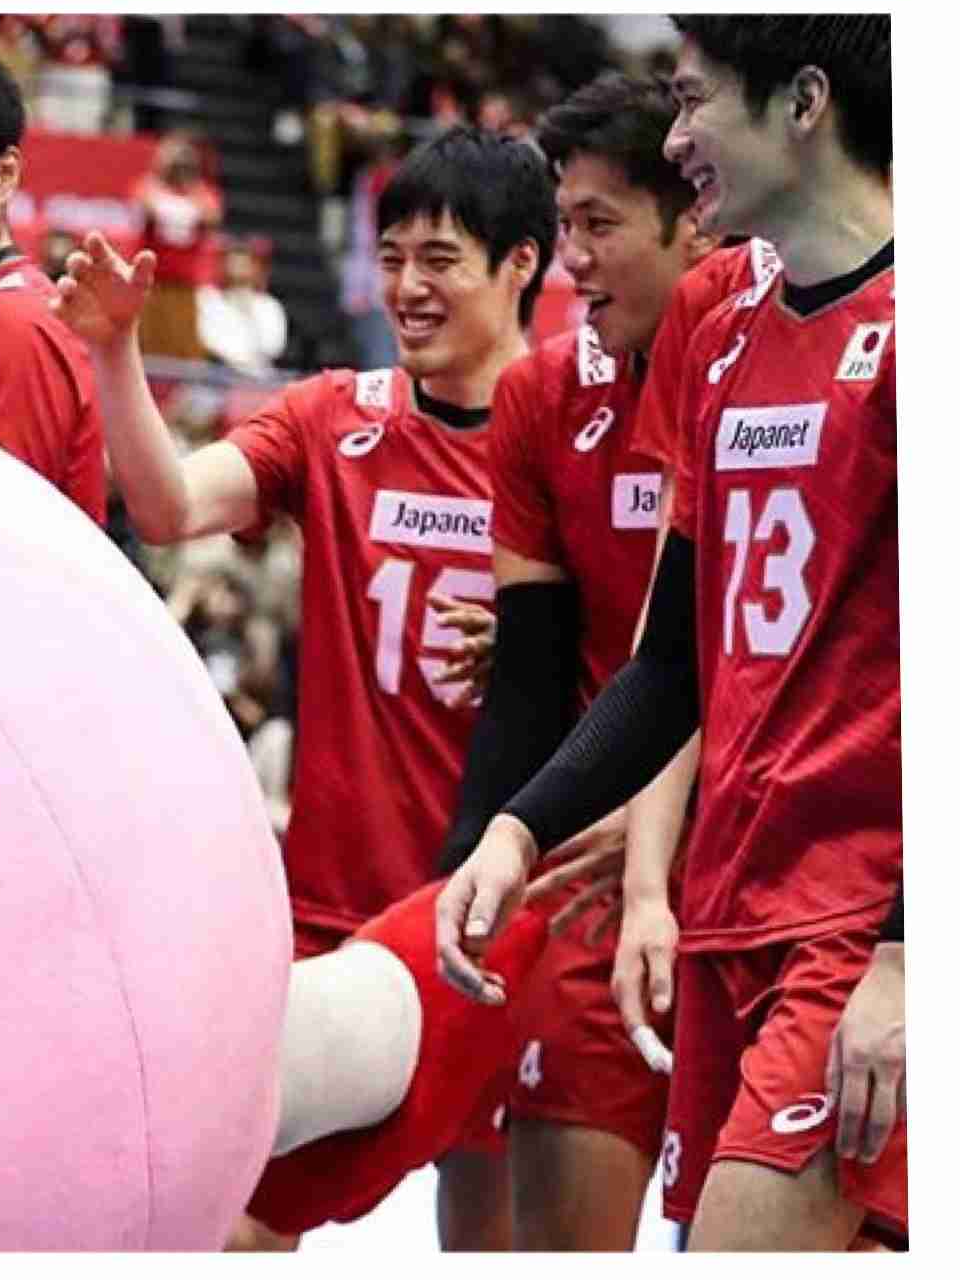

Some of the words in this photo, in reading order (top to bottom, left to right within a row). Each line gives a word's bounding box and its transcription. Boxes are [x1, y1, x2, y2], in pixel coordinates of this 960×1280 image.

[728, 419, 810, 457] Japanet
[628, 483, 661, 512] Ja
[391, 503, 492, 536] Japane
[723, 487, 817, 657] 13
